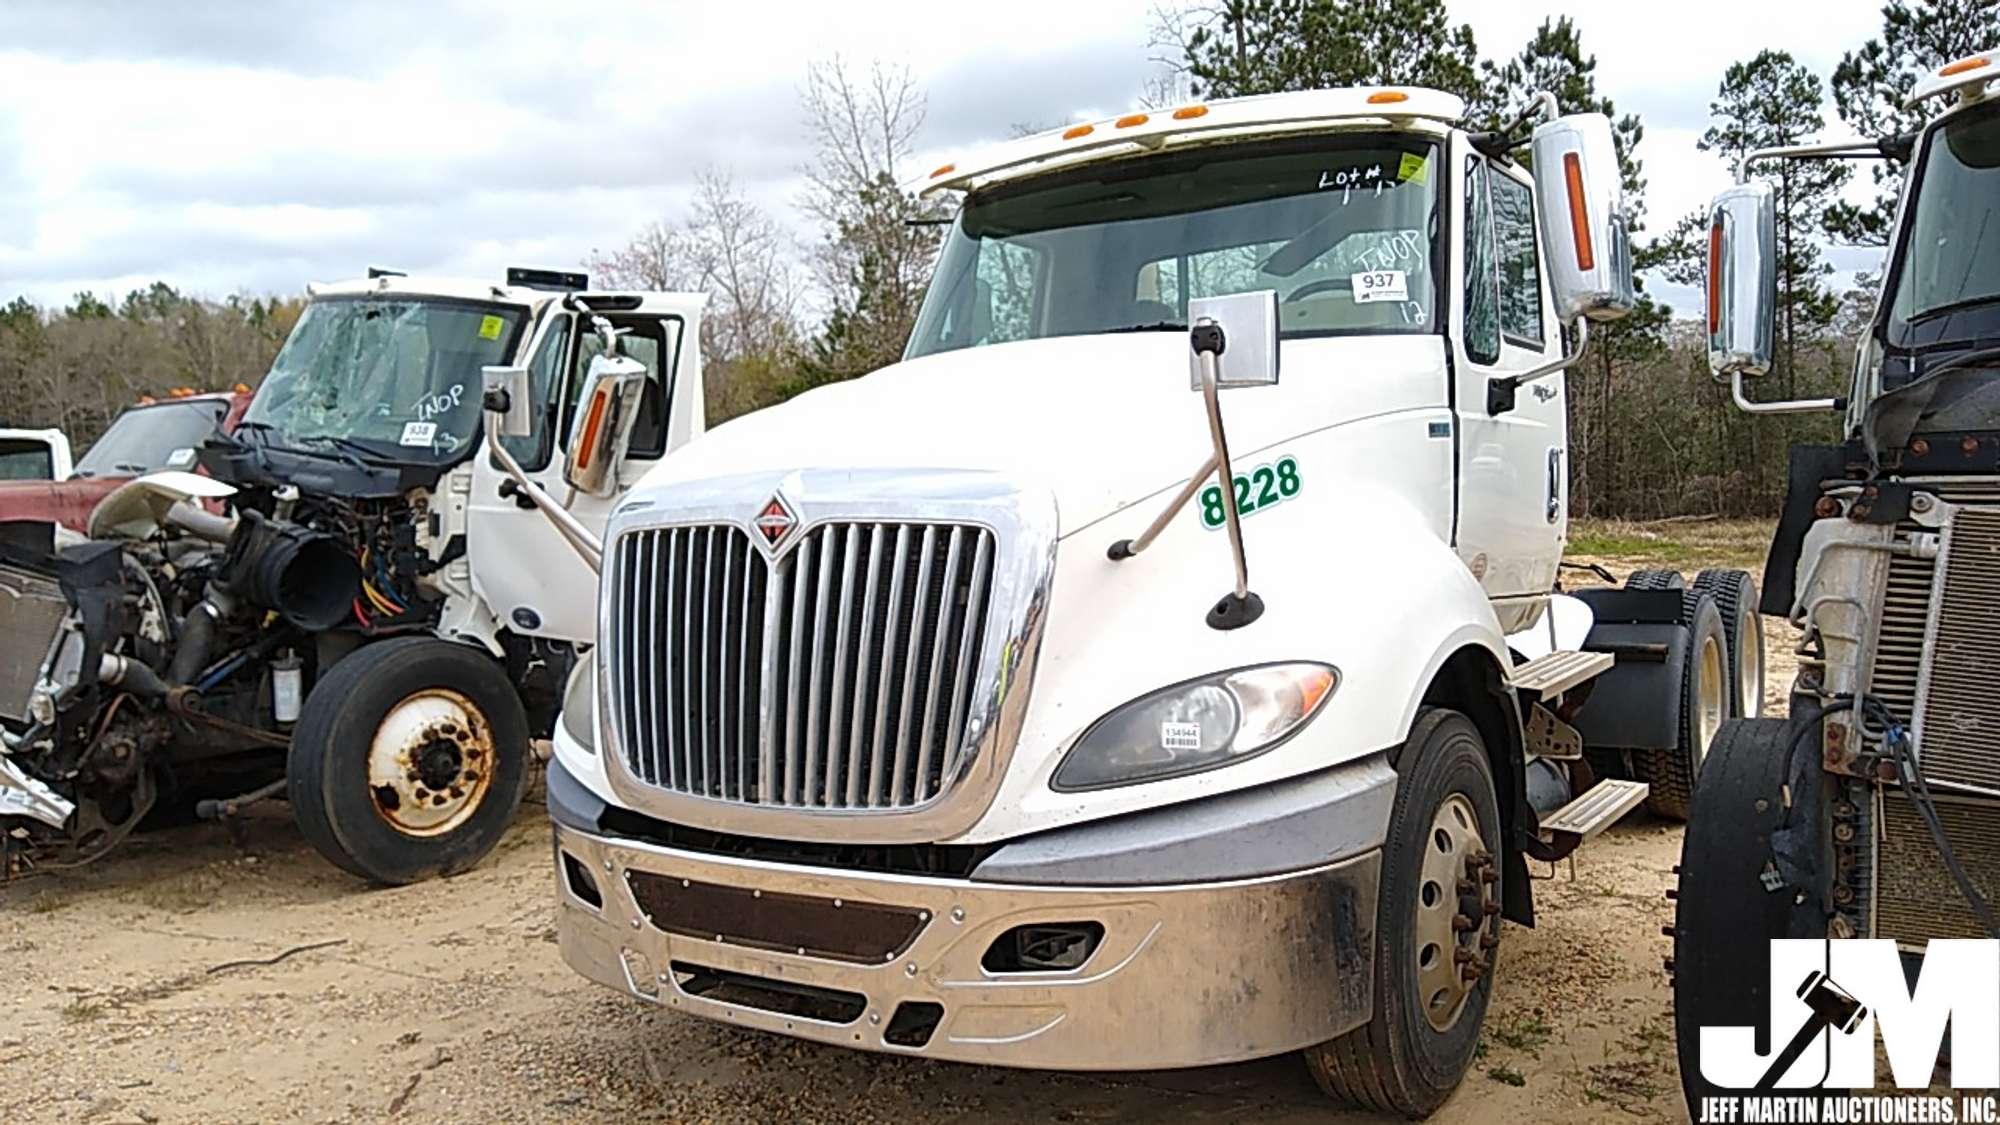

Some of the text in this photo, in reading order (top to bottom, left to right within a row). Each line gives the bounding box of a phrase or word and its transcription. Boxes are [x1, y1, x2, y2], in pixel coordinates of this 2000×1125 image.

[1353, 229, 1424, 273] INOP
[1363, 273, 1394, 289] 937
[1400, 300, 1427, 325] 12
[433, 431, 459, 457] 13
[1201, 458, 1300, 527] 8228
